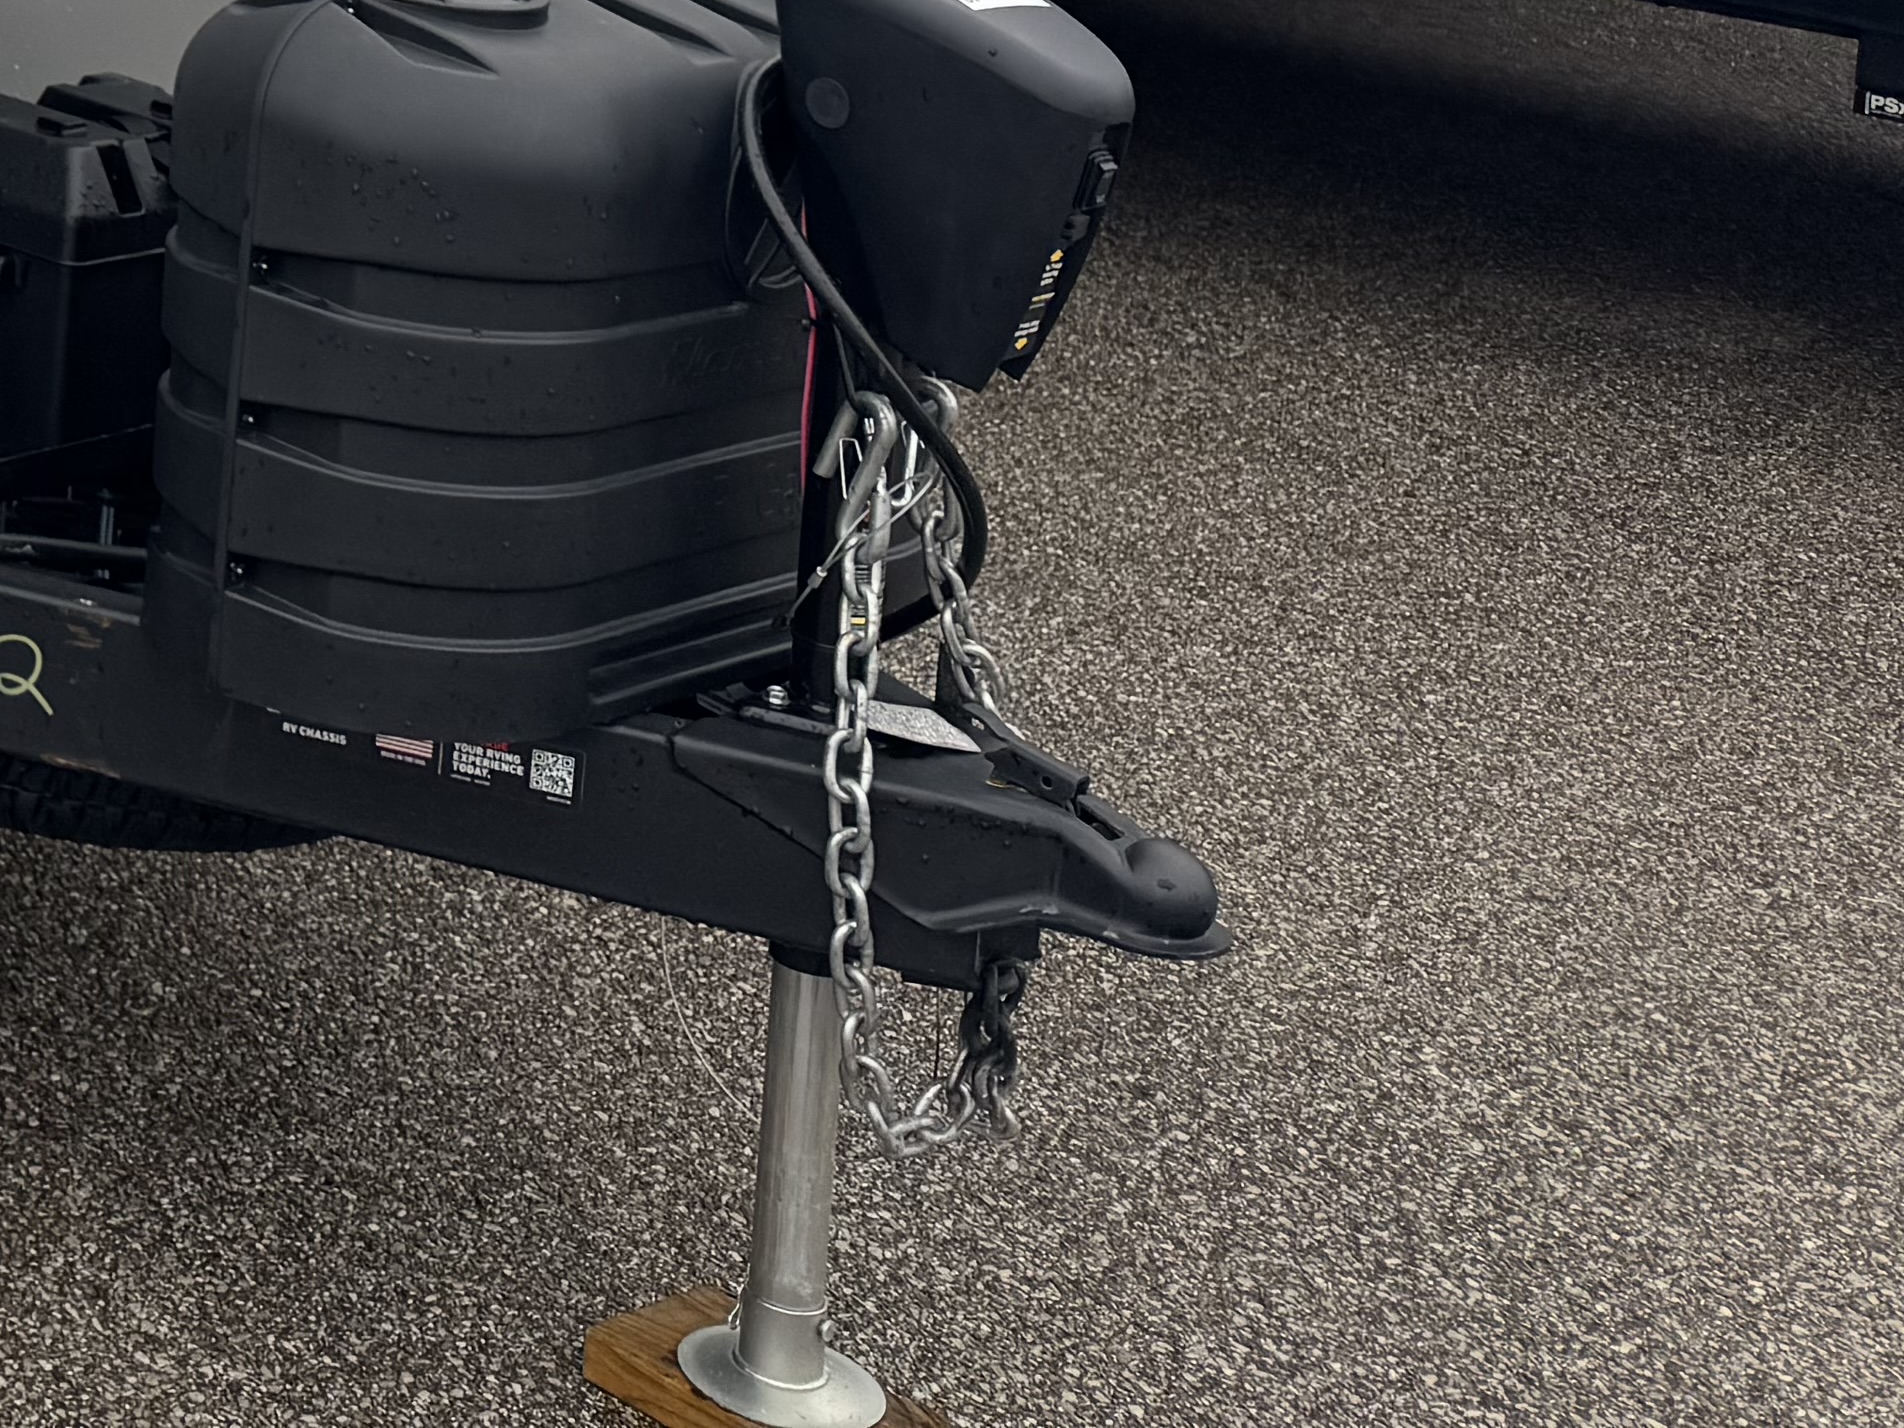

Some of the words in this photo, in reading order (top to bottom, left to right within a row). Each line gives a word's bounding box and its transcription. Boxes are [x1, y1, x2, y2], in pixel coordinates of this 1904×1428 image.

[282, 721, 298, 734] RV
[298, 725, 347, 746] CHASSIS
[452, 751, 525, 777] EXPERIENCE
[454, 742, 484, 757] YOUR
[486, 748, 521, 765] RVING
